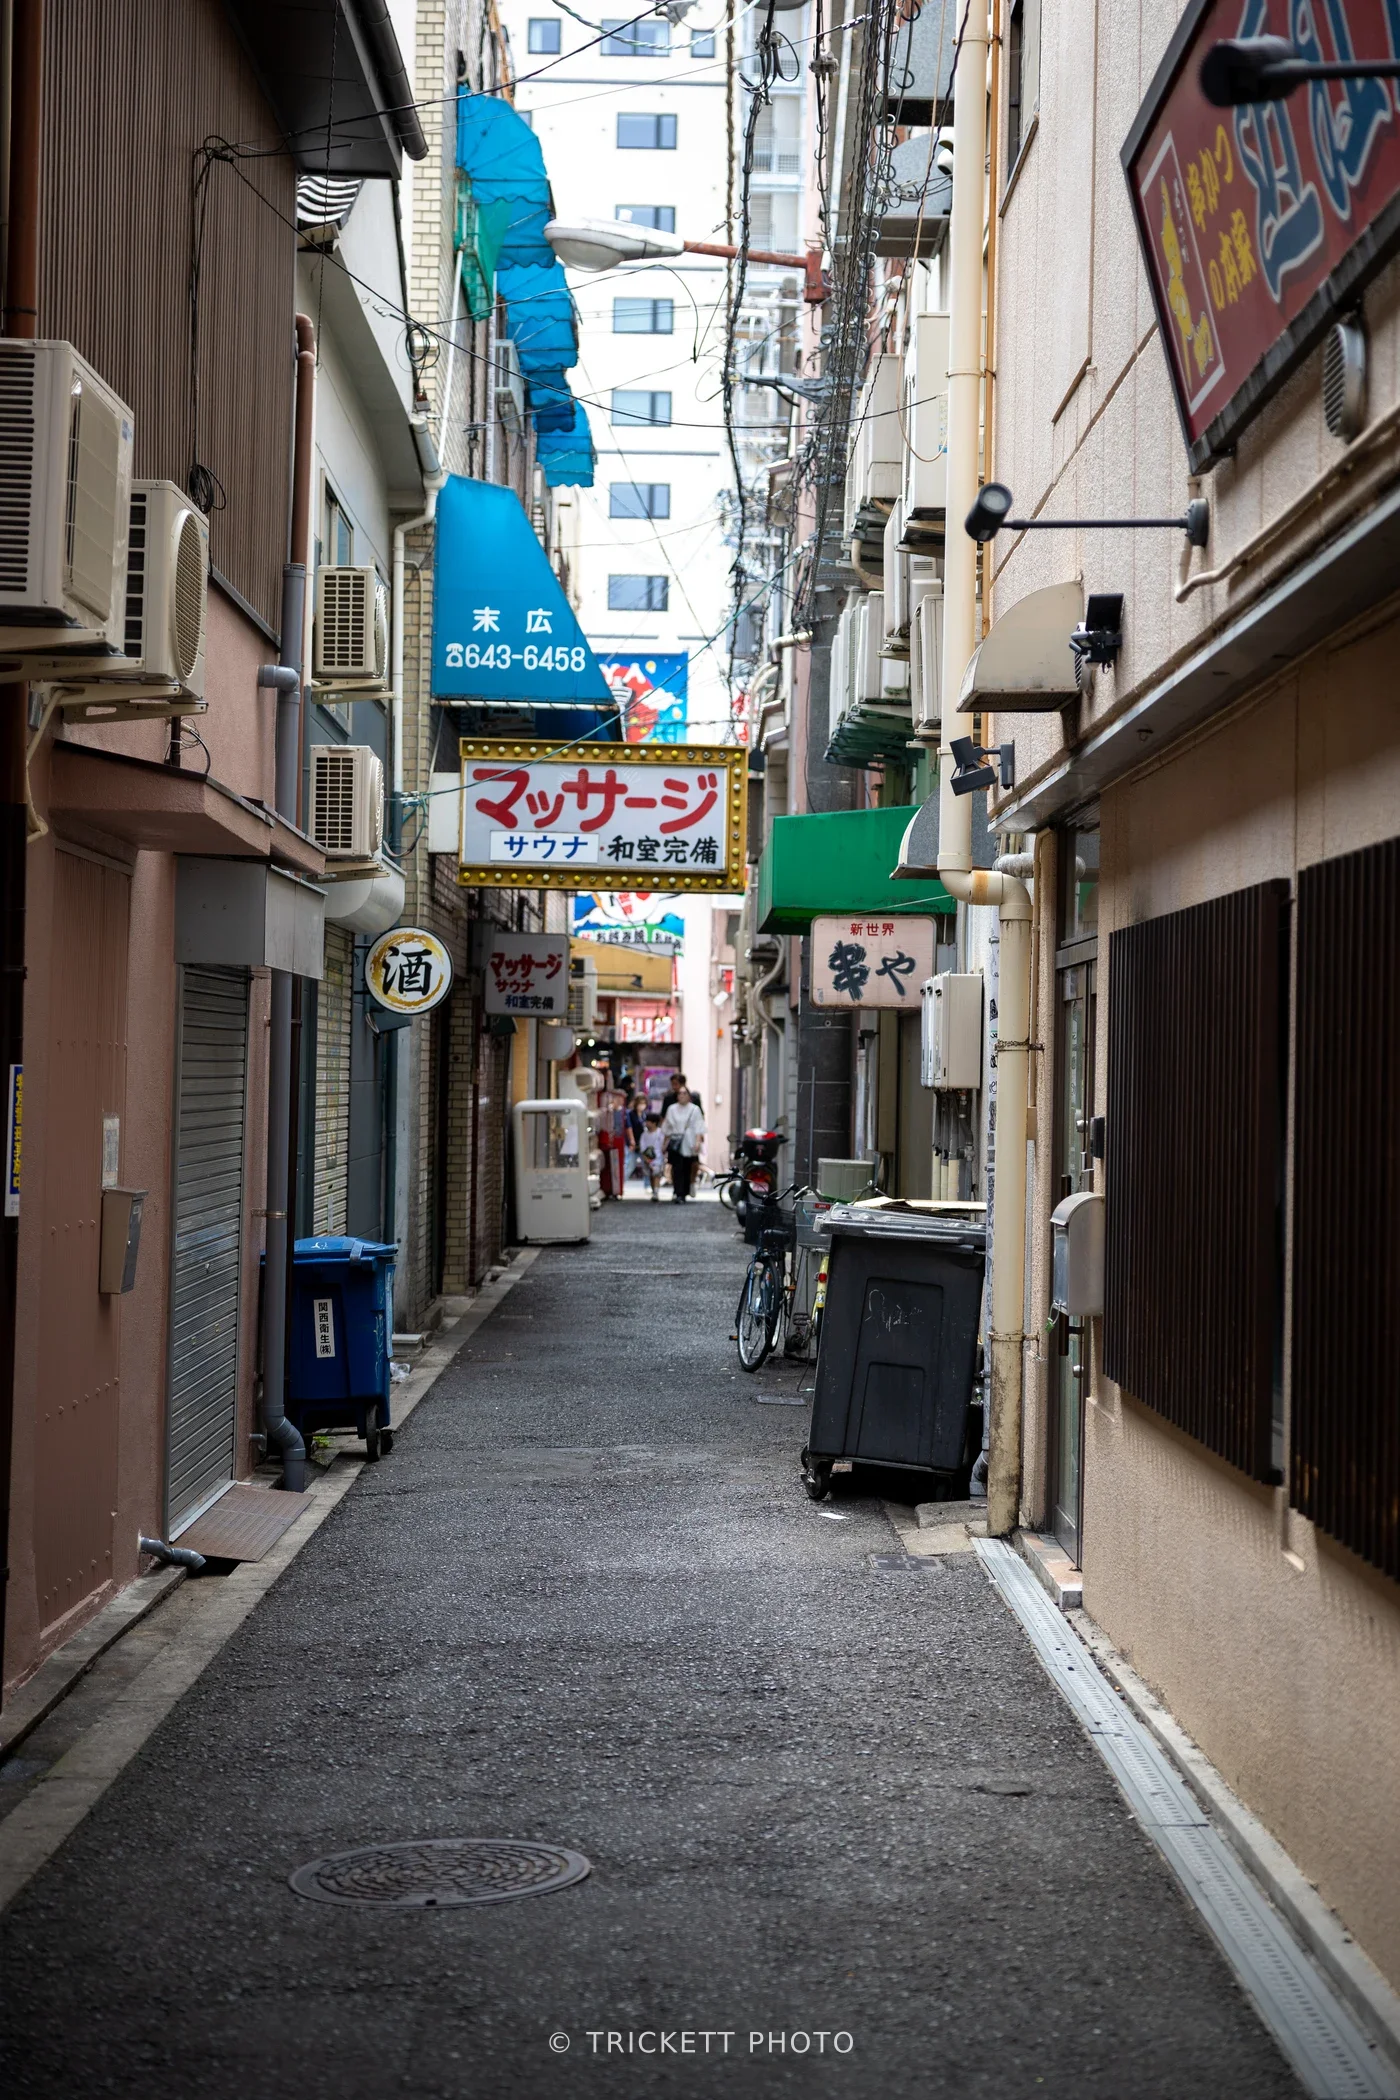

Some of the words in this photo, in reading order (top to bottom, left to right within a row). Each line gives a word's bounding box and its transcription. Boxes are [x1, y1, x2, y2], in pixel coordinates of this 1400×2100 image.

[472, 768, 718, 834] マッサージ
[503, 835, 588, 860] サウナ
[850, 923, 895, 937] 新世界
[381, 946, 433, 996] 酒
[489, 952, 563, 980] マッサージ
[828, 940, 916, 1001] 串や
[495, 979, 535, 994] サウナ
[505, 995, 554, 1010] 和室完備
